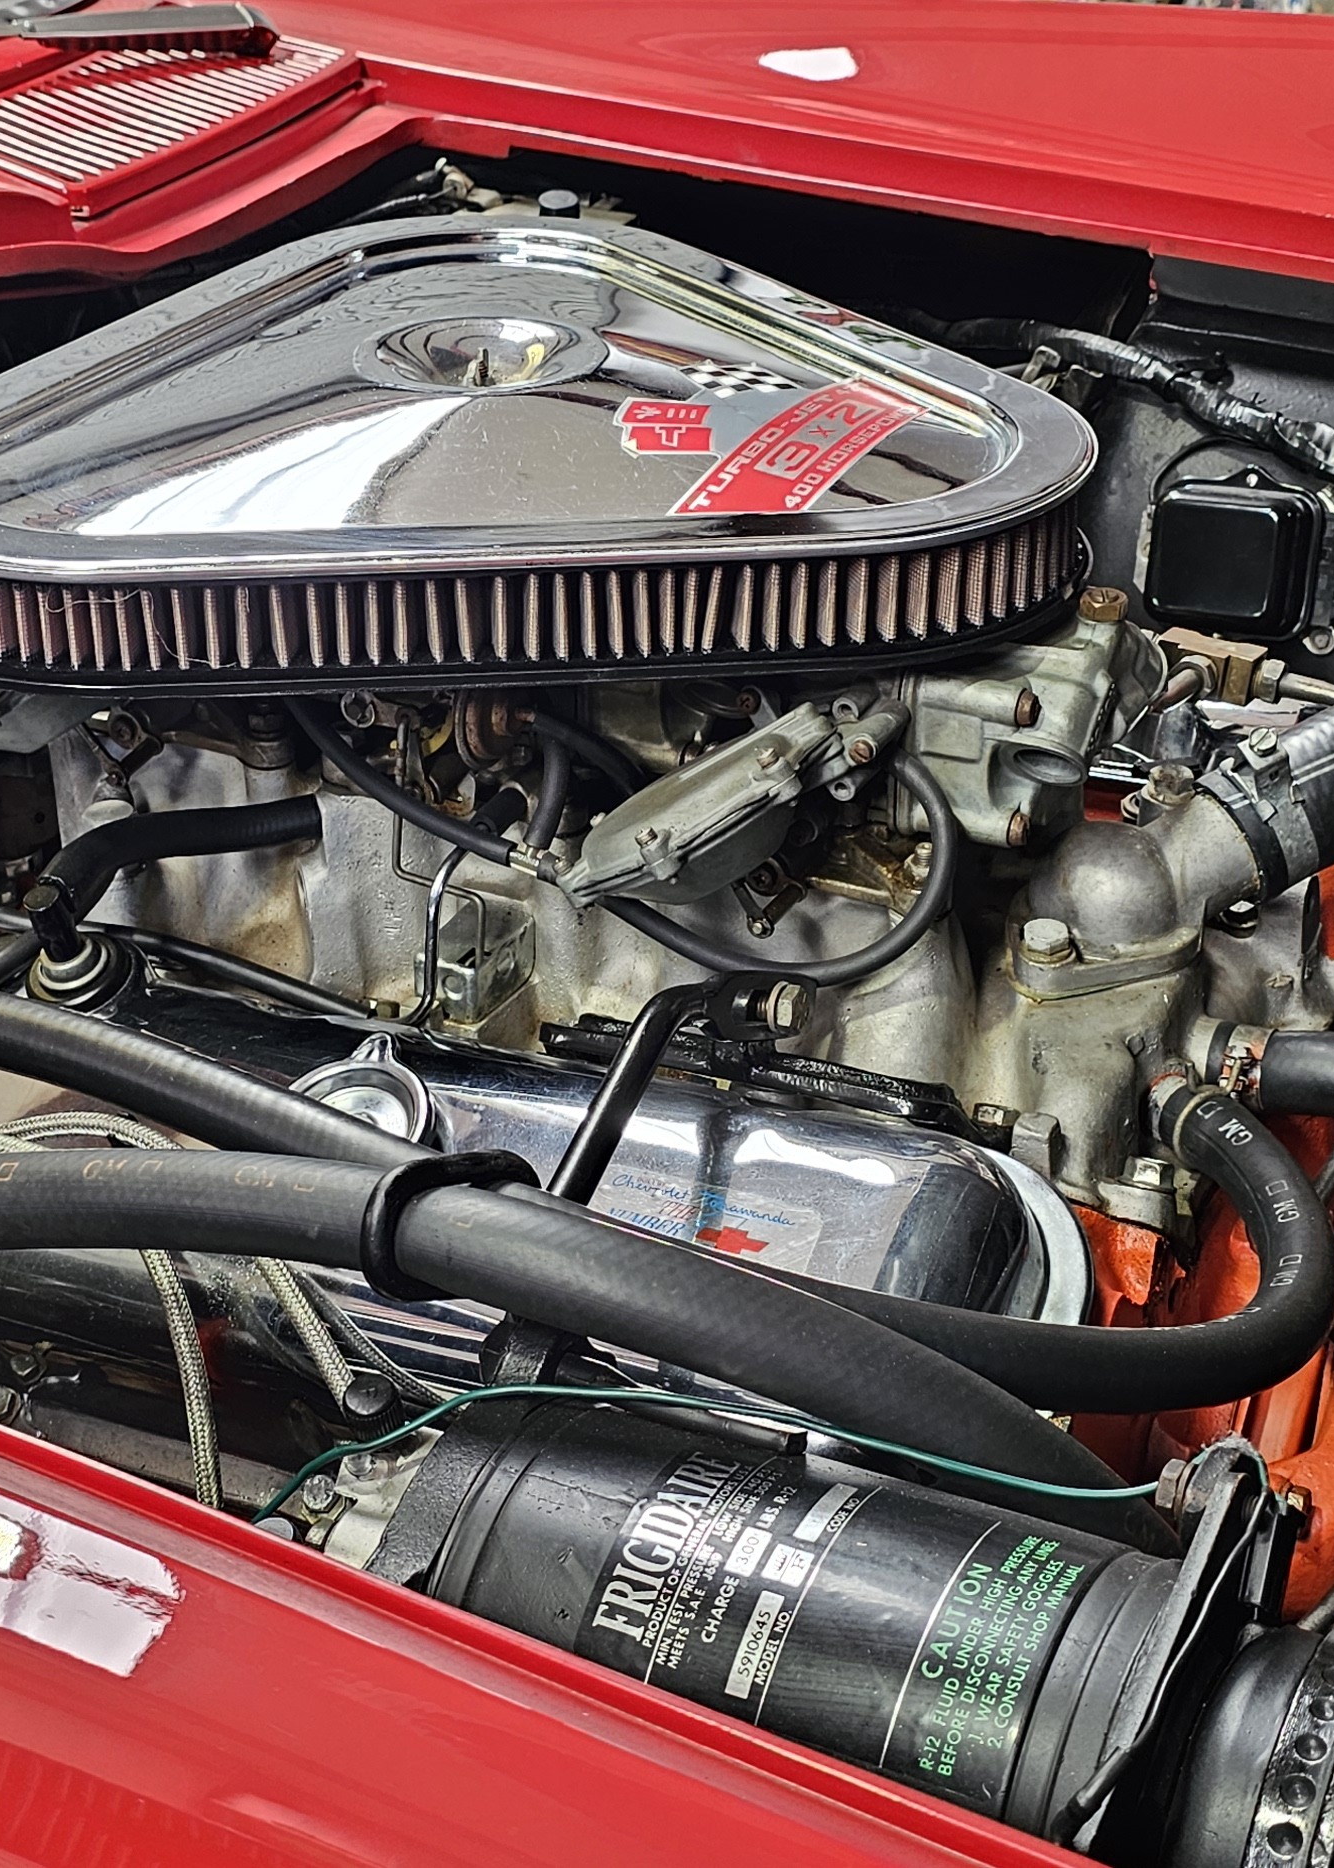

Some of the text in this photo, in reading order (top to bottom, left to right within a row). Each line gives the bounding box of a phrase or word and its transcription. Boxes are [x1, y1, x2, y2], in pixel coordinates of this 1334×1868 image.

[687, 393, 831, 511] TURBO-JET
[766, 438, 821, 474] 3
[826, 401, 878, 426] 2
[784, 467, 823, 509] 400
[82, 1159, 128, 1181] GM
[1218, 1118, 1254, 1146] GM
[612, 1173, 691, 1200] Chevrolet
[1273, 1198, 1301, 1223] GM
[592, 1451, 742, 1642] FRIGIDAIRE
[825, 1507, 850, 1534] CODE
[642, 1585, 673, 1648] PRODUCT
[666, 1565, 682, 1586] OF
[678, 1511, 713, 1569] GENERAL
[710, 1476, 742, 1517] MOTORS
[655, 1622, 674, 1666] MIN.
[667, 1600, 687, 1628] TEST
[680, 1543, 714, 1599] PRESSURE
[712, 1511, 733, 1537] LOW
[728, 1490, 749, 1513] SIDE
[743, 1475, 760, 1495] 140
[667, 1627, 691, 1670] MEETS
[721, 1515, 743, 1543] HIGH
[741, 1493, 761, 1519] SIDE
[756, 1479, 774, 1499] 300
[700, 1575, 741, 1643] CHARGE
[756, 1499, 783, 1530] LBS.
[774, 1485, 798, 1505] R-12
[737, 1609, 773, 1680] 5910645
[753, 1610, 793, 1687] MODEL NO.
[919, 1535, 1044, 1771] R-12 FLUID UNDER HIGH PRESSURE
[921, 1562, 993, 1679] CAUTION
[974, 1671, 1005, 1722] WEAR
[996, 1614, 1030, 1668] SAFETY
[1022, 1559, 1066, 1613] GOGGLES.
[1023, 1611, 1051, 1653] SHOP
[937, 1708, 970, 1777] BEFORE
[960, 1585, 1023, 1704] DISCONNECTING
[1016, 1560, 1039, 1586] ANY
[993, 1653, 1033, 1730] CONSULT
[987, 1735, 1005, 1750] 2.
